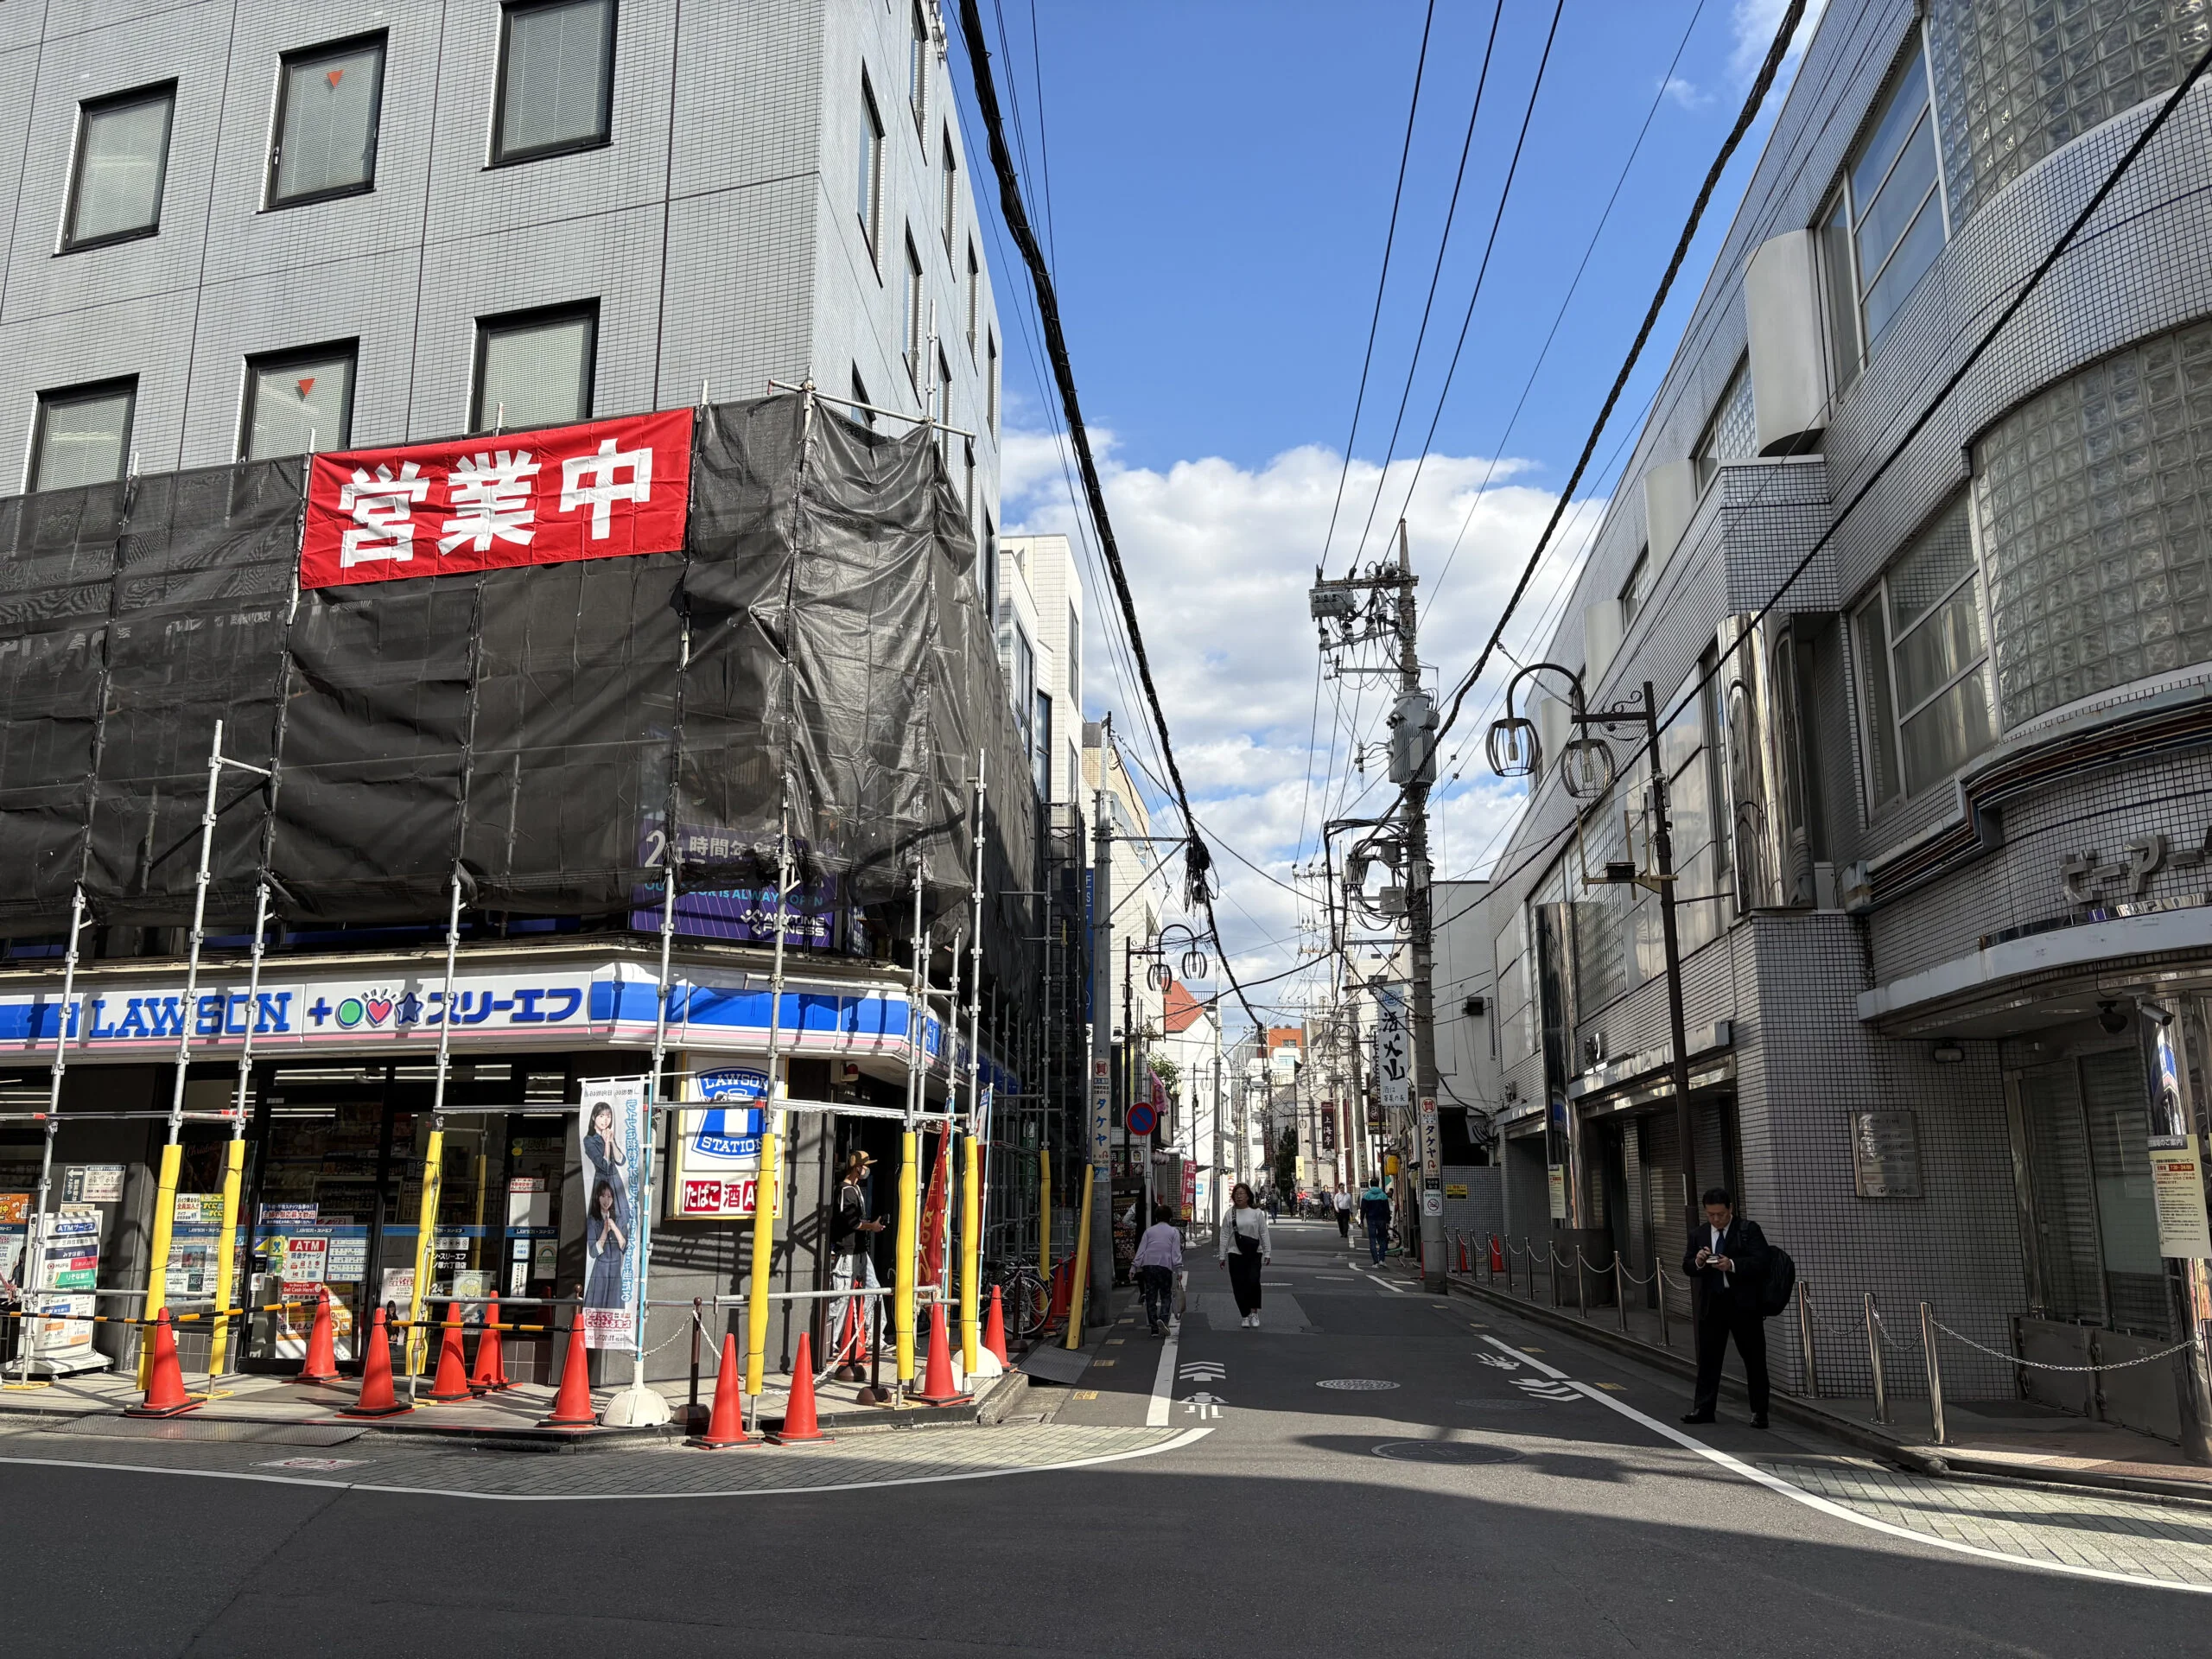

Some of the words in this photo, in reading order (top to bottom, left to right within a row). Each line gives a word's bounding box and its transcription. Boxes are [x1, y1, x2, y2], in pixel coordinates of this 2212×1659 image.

[338, 438, 652, 568] 営業中
[2059, 825, 2212, 903] ピーアー
[734, 886, 783, 902] ALWAY
[90, 992, 293, 1038] LAWSON
[428, 988, 584, 1025] スリーエフ
[704, 1073, 769, 1090] LAWSON
[1095, 1098, 1107, 1147] タケヤ
[1323, 1116, 1332, 1145] 上海亭
[1426, 1125, 1436, 1158] タケヤ
[685, 1183, 721, 1208] たばこ
[723, 1183, 741, 1208] 酒
[1186, 1163, 1197, 1204] 正社員
[57, 1224, 93, 1232] ATMサービス
[295, 1240, 320, 1251] ATM
[432, 1283, 444, 1294] 24
